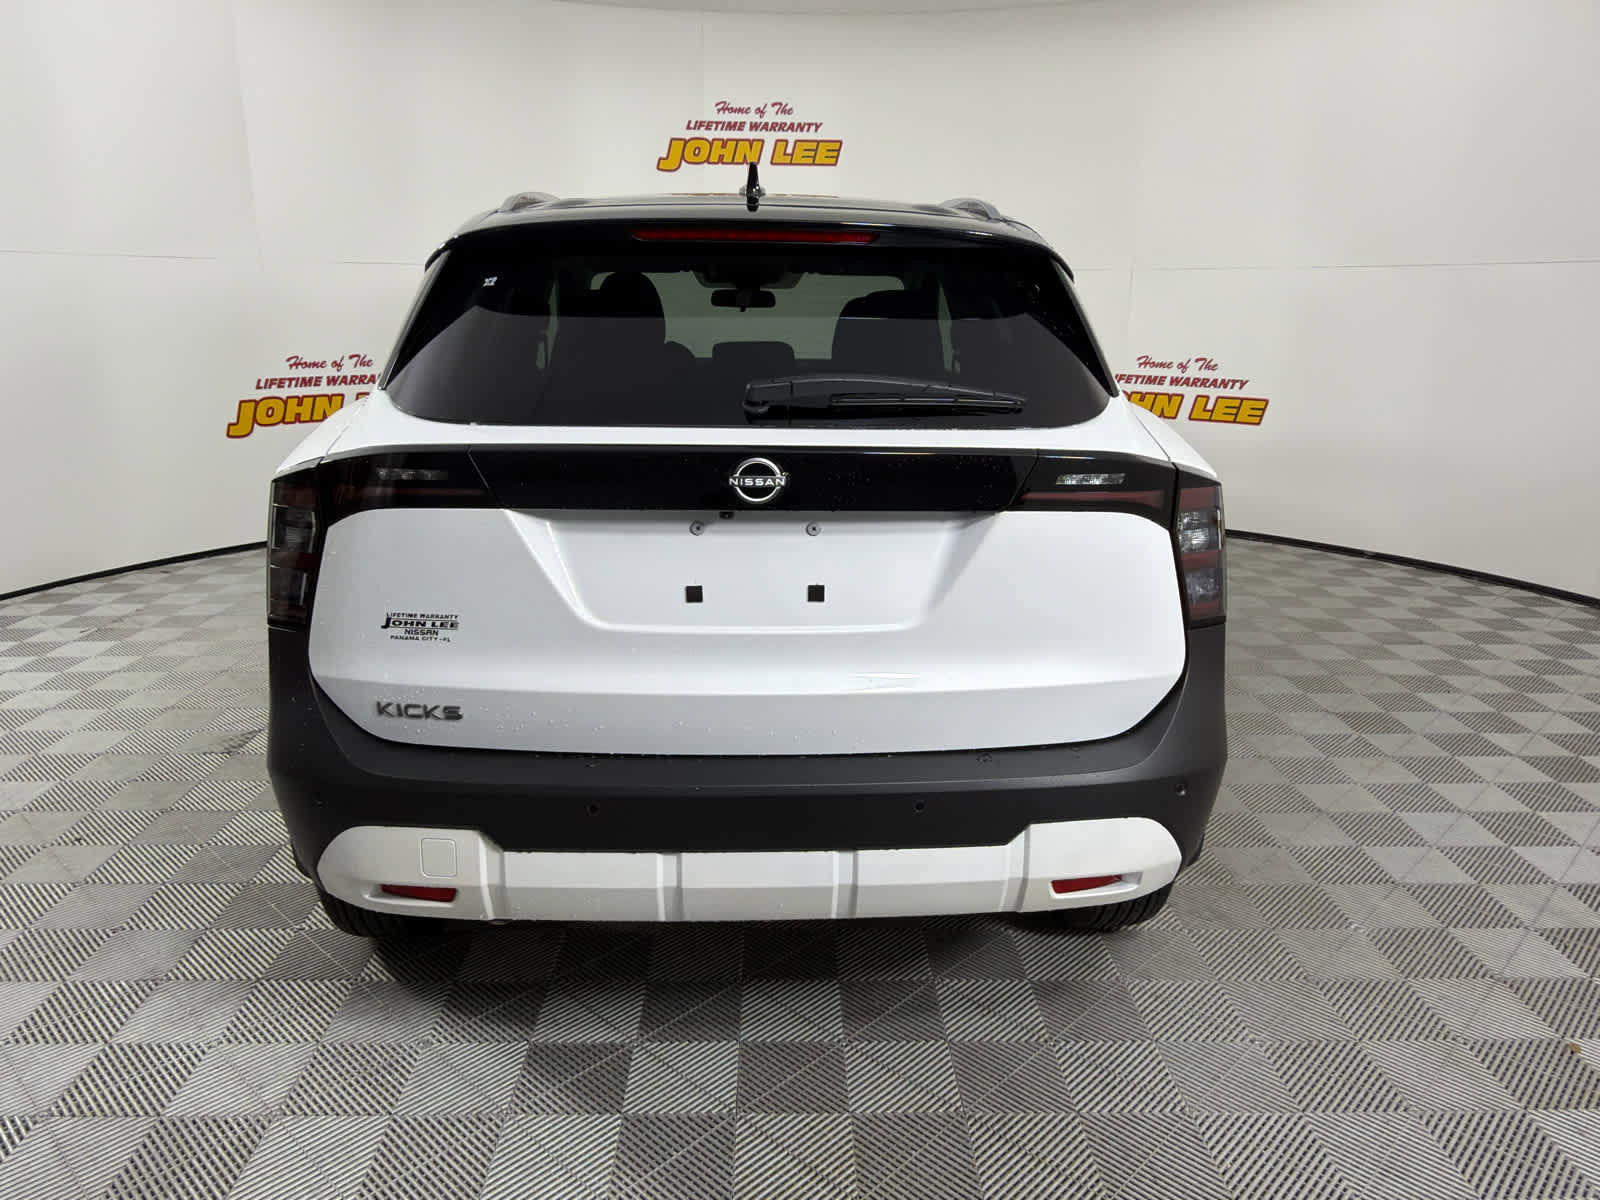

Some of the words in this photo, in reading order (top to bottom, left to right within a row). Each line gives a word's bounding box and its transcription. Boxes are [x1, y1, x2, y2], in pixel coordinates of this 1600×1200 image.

[715, 100, 751, 115] Home
[754, 103, 768, 118] of
[771, 102, 794, 116] The
[685, 120, 746, 132] LIFETIME
[749, 122, 823, 133] WARRANTY
[656, 137, 765, 172] JOHN
[770, 139, 843, 166] LEE
[286, 355, 327, 370] Home
[331, 355, 345, 372] of
[348, 353, 374, 369] The
[1136, 355, 1174, 369] Home
[1176, 358, 1191, 373] of
[1194, 357, 1219, 372] The
[255, 376, 323, 390] LIFETIME
[326, 372, 382, 386] WARRA
[1169, 376, 1249, 390] WARRANTY
[226, 393, 345, 439] JOHN
[1188, 394, 1269, 426] LEE
[729, 478, 785, 486] NISSAN
[381, 617, 427, 629] JOHN
[376, 701, 463, 721] KICKS
